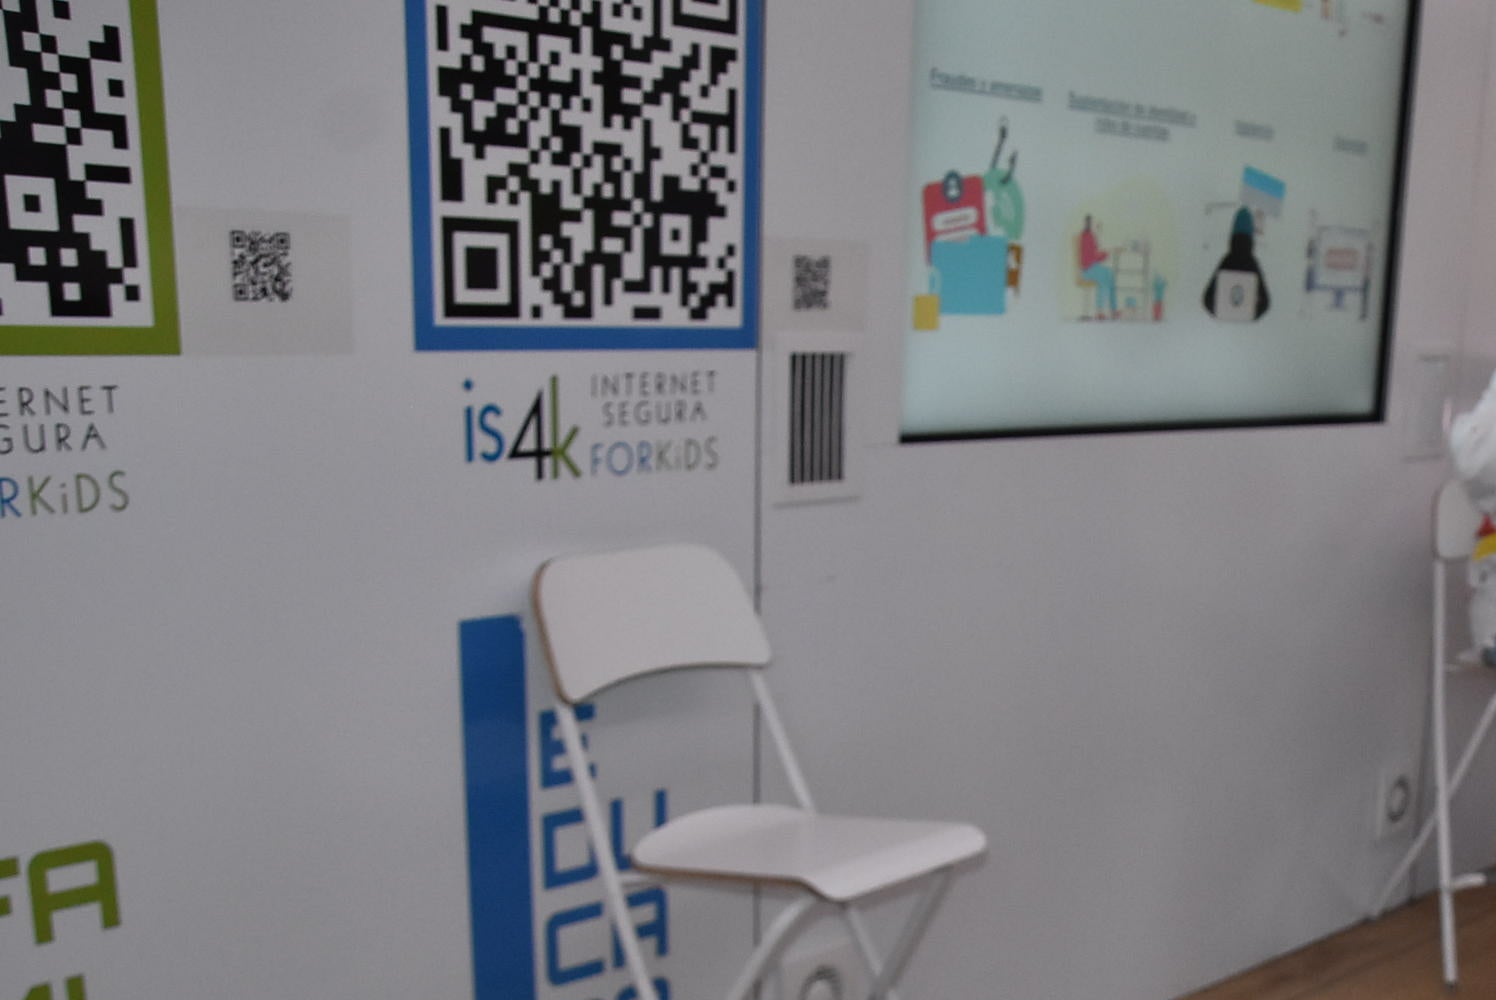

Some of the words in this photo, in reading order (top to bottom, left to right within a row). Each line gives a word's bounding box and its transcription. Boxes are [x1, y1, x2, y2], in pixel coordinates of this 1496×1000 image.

[590, 369, 718, 398] INTERNET
[601, 400, 706, 428] SEGURA
[462, 373, 582, 481] is4k
[545, 887, 669, 987] CA
